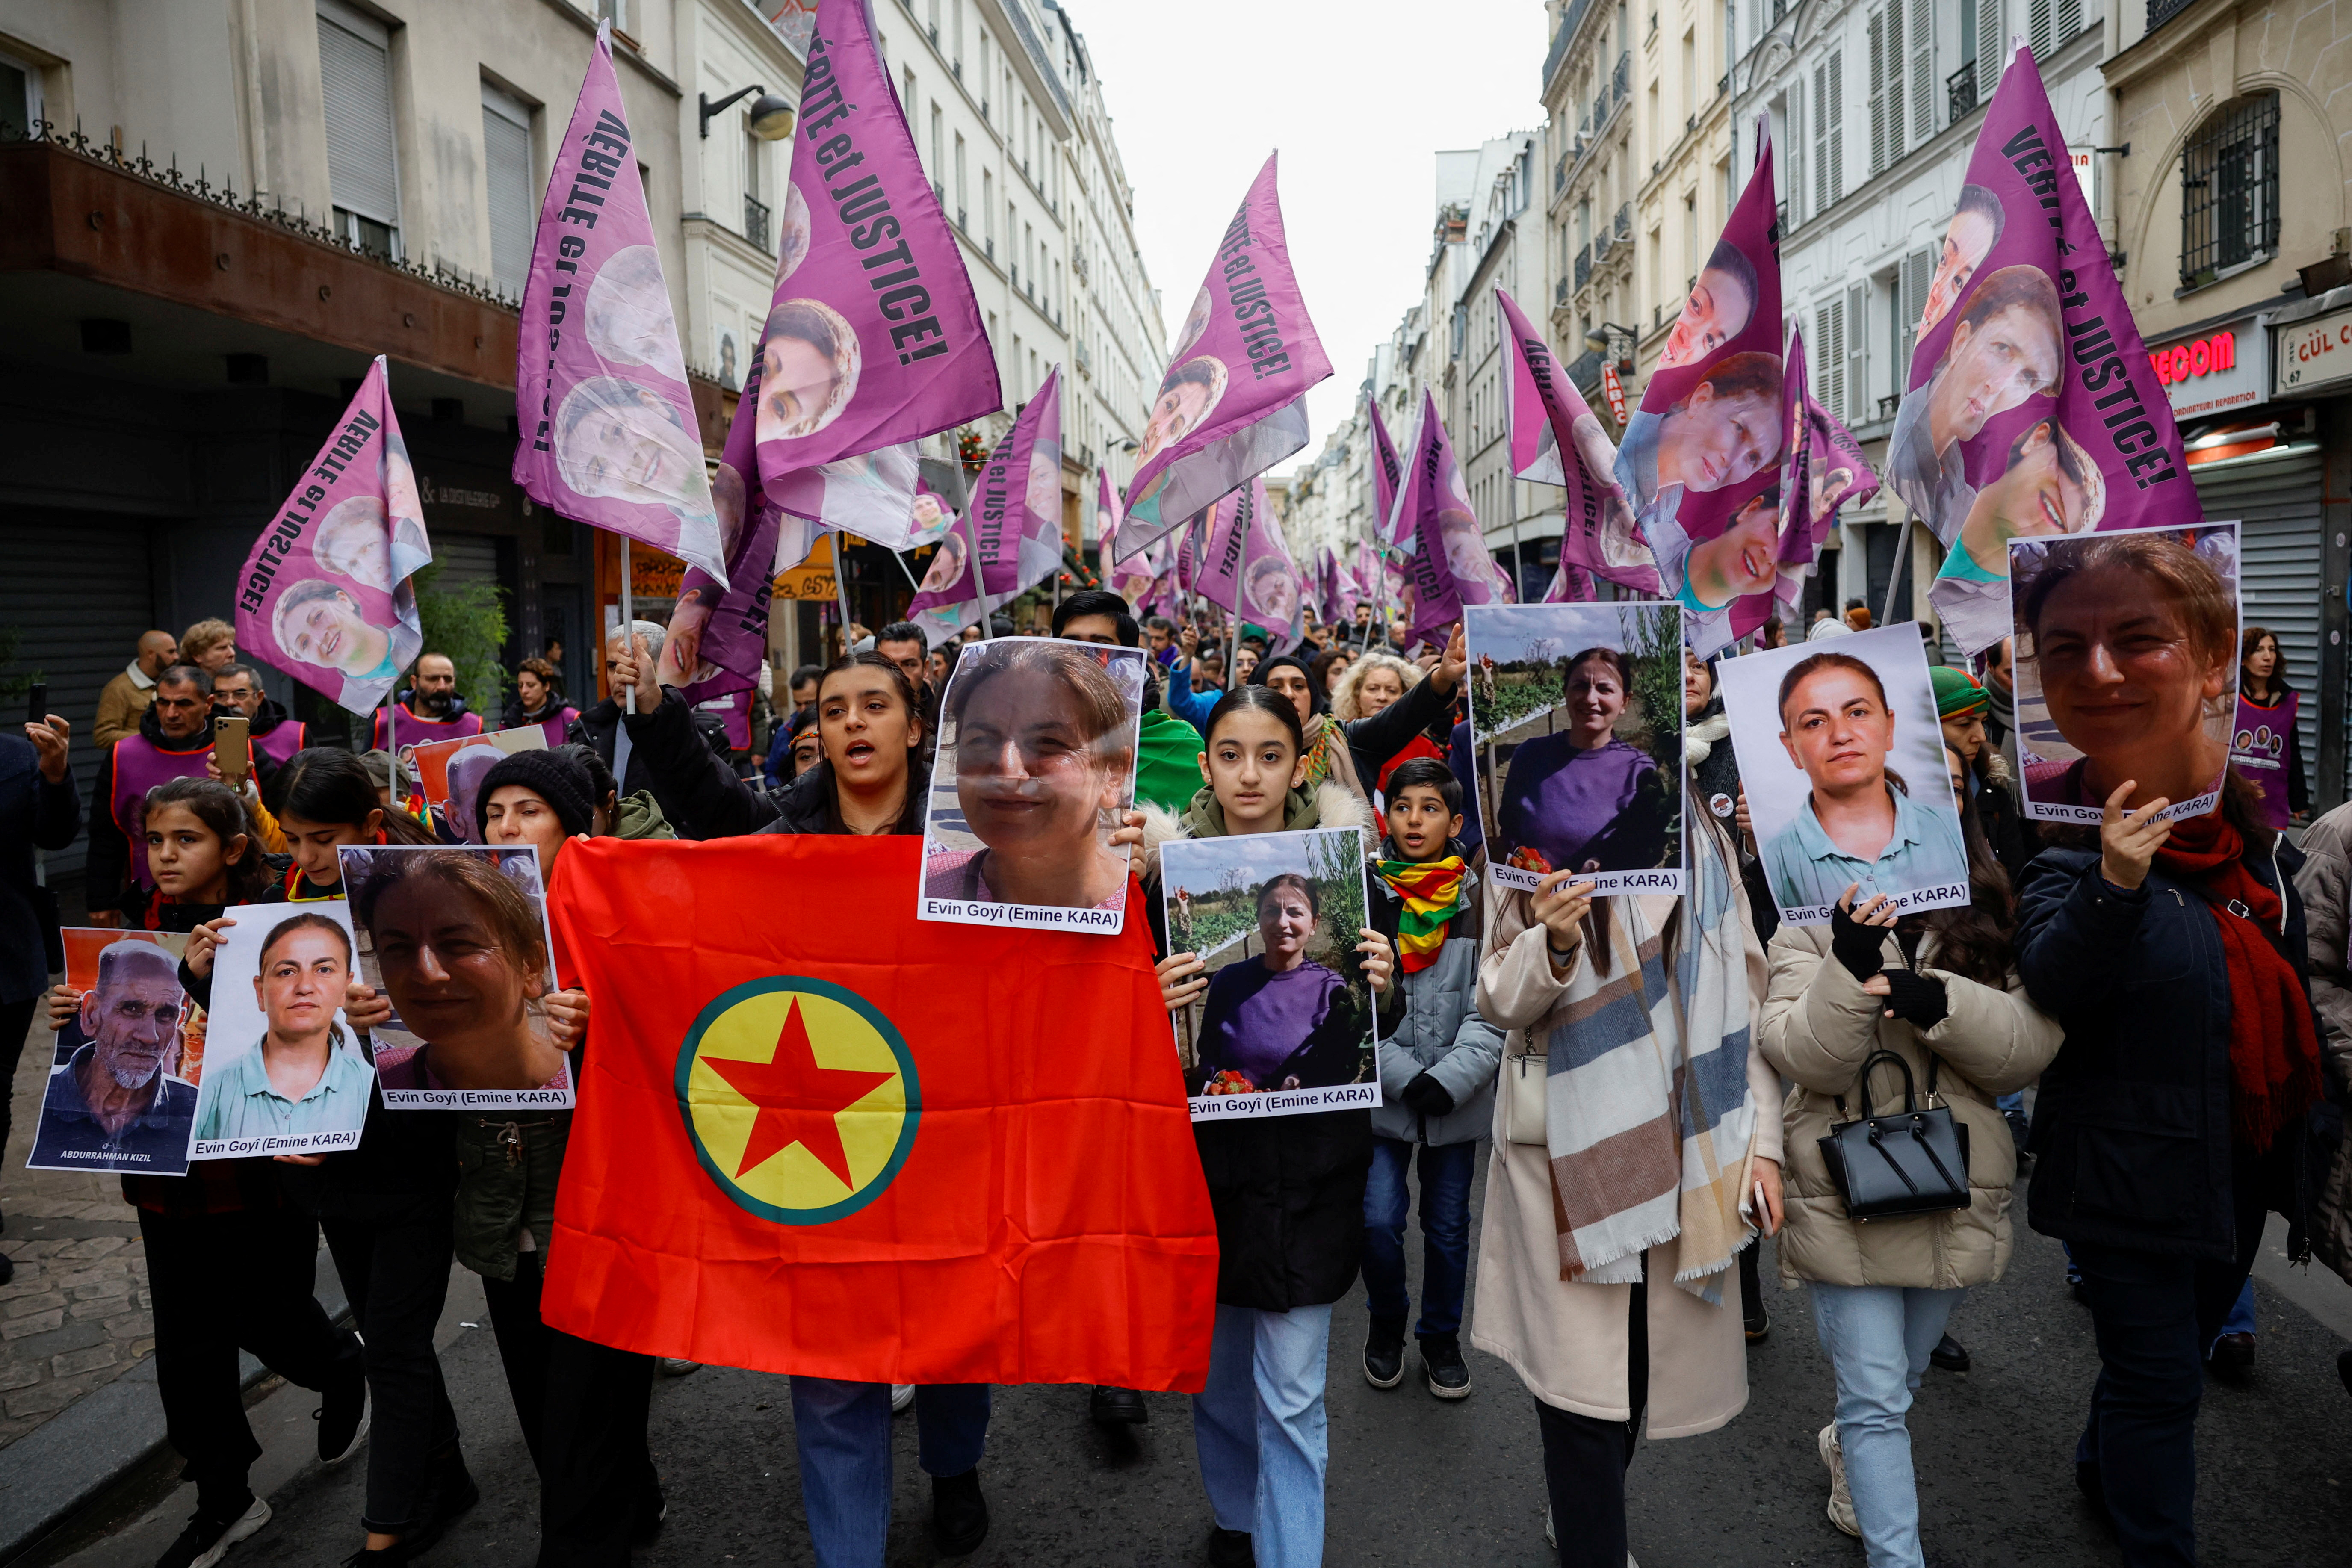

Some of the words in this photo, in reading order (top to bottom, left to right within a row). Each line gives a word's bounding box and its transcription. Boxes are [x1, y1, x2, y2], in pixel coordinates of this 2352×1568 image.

[800, 27, 858, 142] ÉRITÉ
[816, 133, 865, 183] et
[830, 173, 949, 366] JUSTICE!
[1224, 255, 1256, 283] et
[1228, 277, 1291, 381] JUSTICE!
[2290, 369, 2301, 383] 67
[1605, 366, 1626, 424] TABAC
[2067, 315, 2178, 491] JUSTICE!
[988, 465, 1006, 484] et
[979, 489, 1007, 566] JUSTICE!
[2034, 804, 2069, 818] Evin
[2174, 794, 2215, 817] KARA)
[1495, 868, 1524, 883] Evin
[1624, 874, 1678, 890] KARA)
[928, 901, 962, 915] Evin
[967, 904, 1003, 921] Goyî
[1008, 906, 1063, 922] (Emine
[1068, 910, 1118, 929] KARA)
[1786, 910, 1816, 921] Evin
[1912, 884, 1965, 904] KARA)
[387, 1092, 419, 1103] Evin
[423, 1092, 457, 1105] Goyî
[461, 1092, 513, 1106] (Emine
[517, 1092, 567, 1105] KARA)
[1189, 1100, 1220, 1114] Evin
[1226, 1097, 1261, 1113] Goyî
[1266, 1093, 1318, 1112] (Emine
[1323, 1087, 1374, 1104] KARA)
[60, 1150, 129, 1161] ABDURRAHMAN
[130, 1154, 151, 1162] KIZIL
[195, 1142, 225, 1154] Evin
[229, 1139, 260, 1152] Goyî
[262, 1136, 308, 1151] (Emine
[312, 1132, 356, 1146] KARA)
